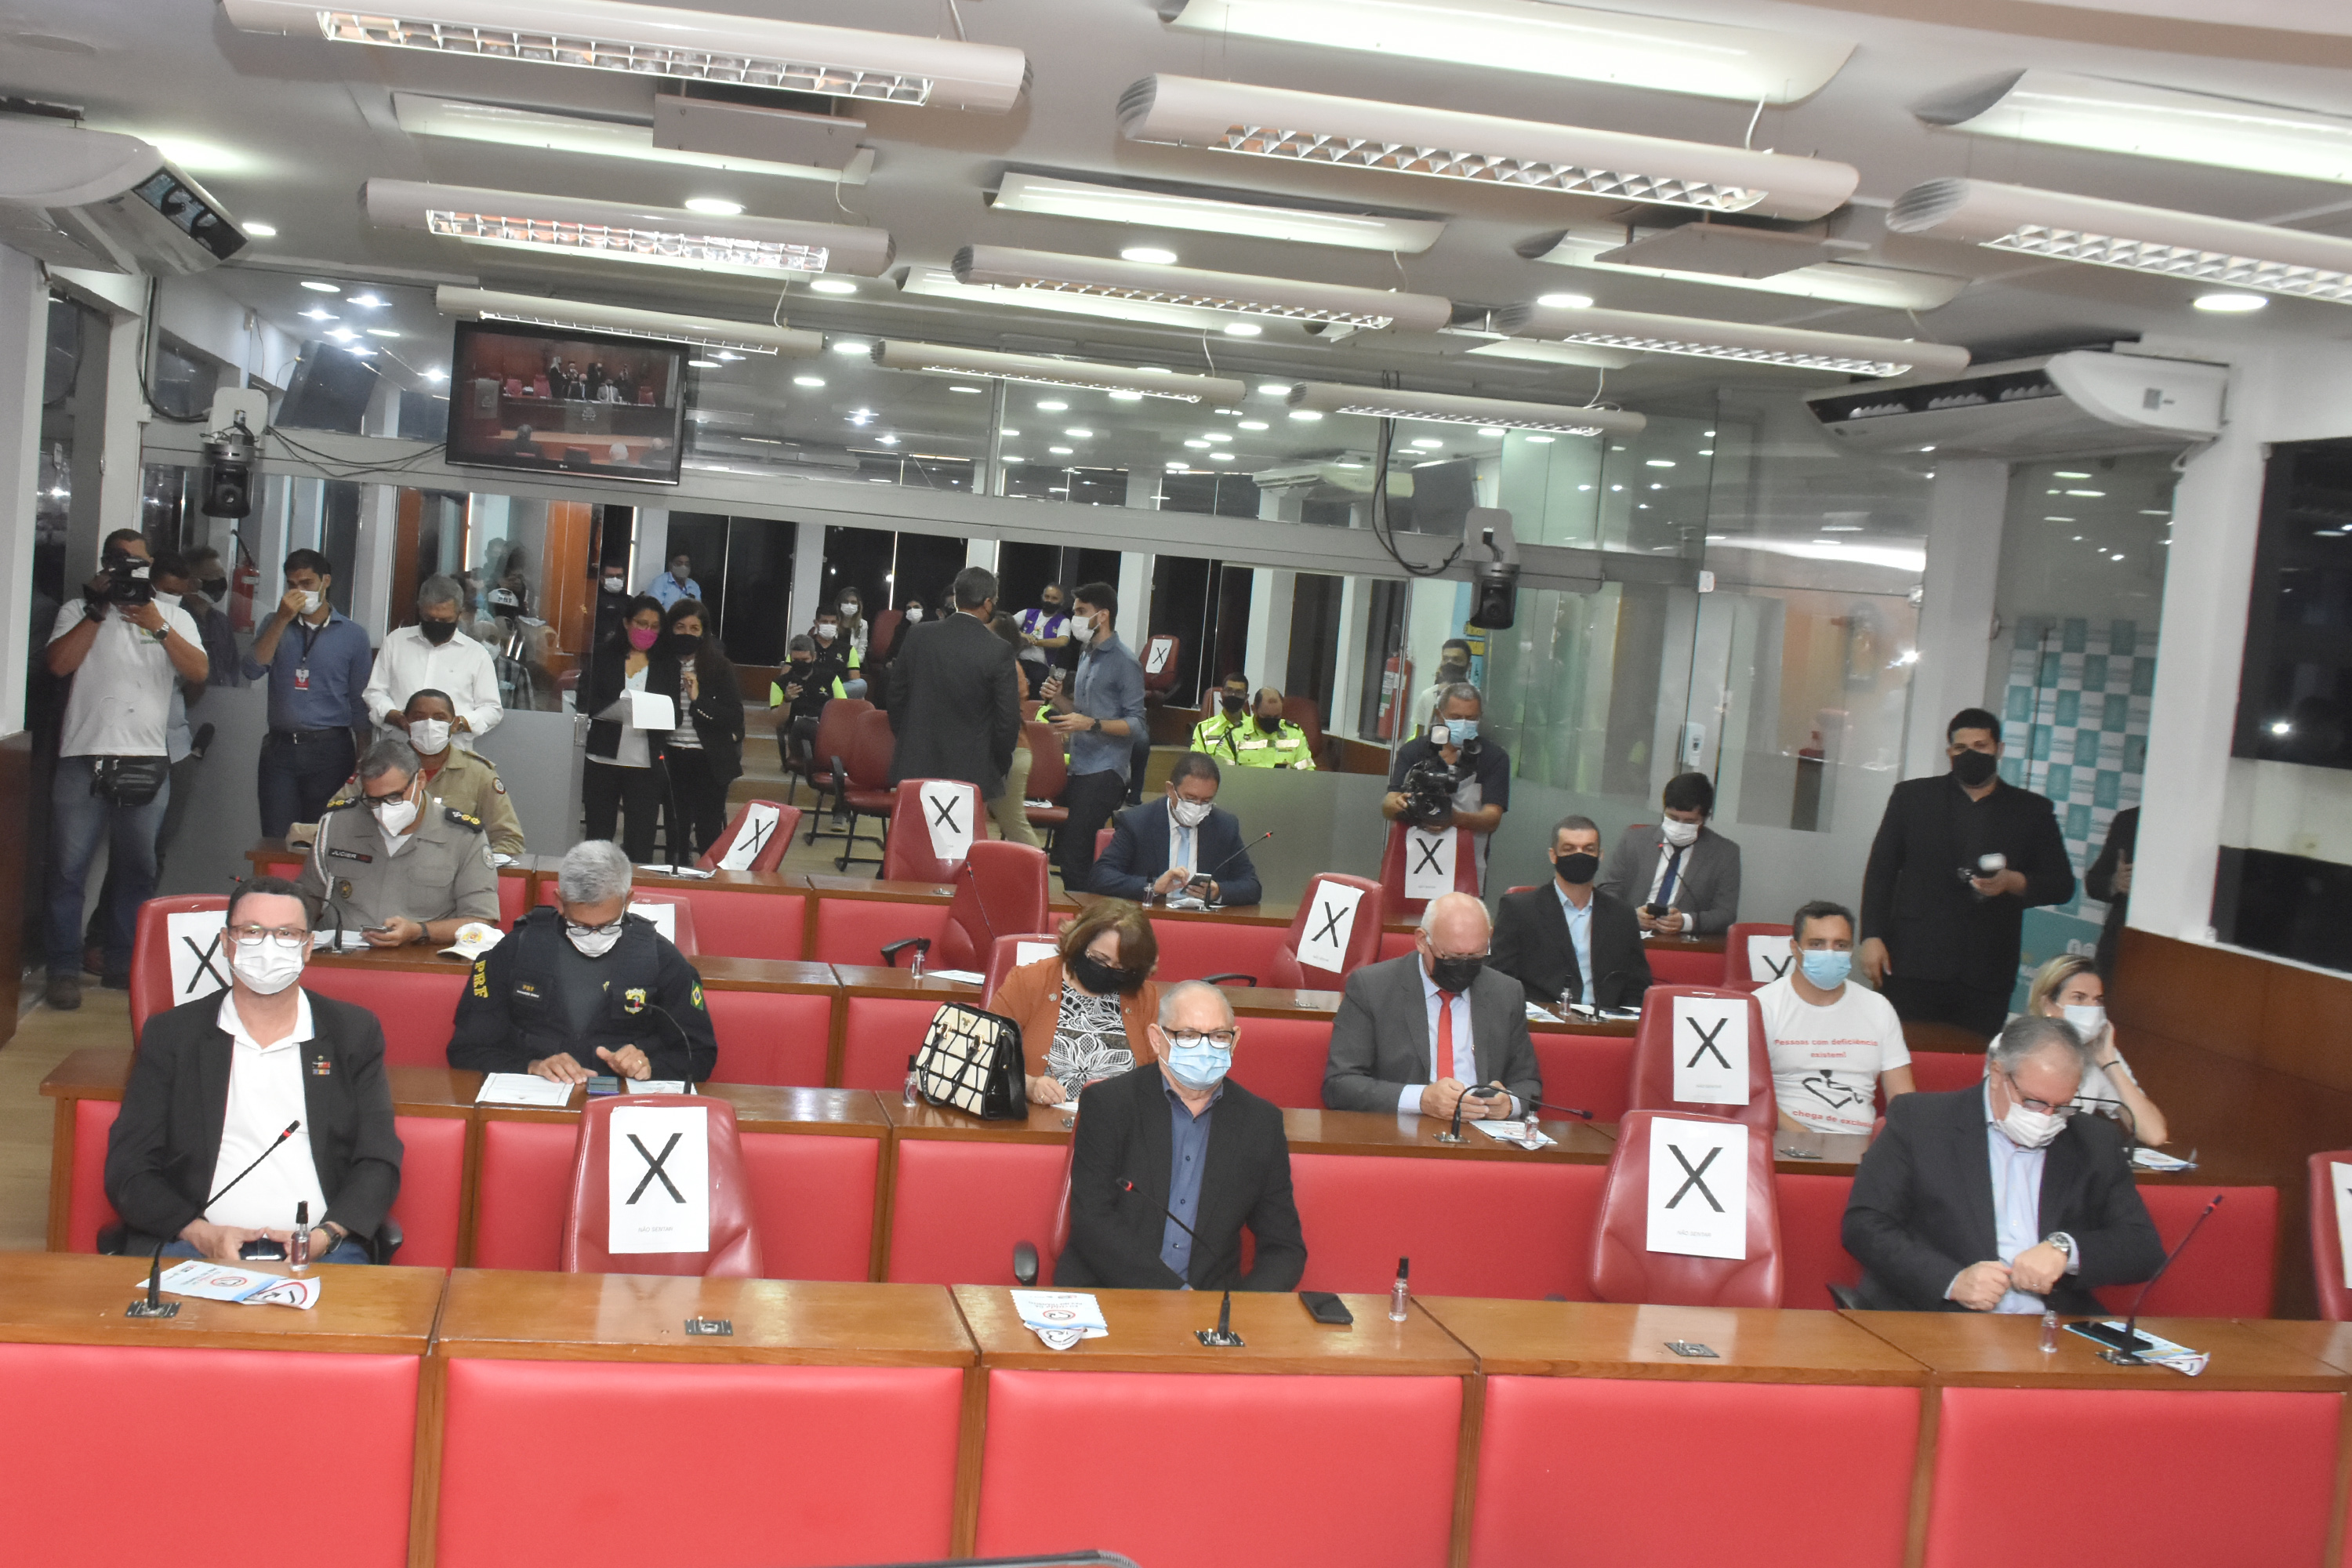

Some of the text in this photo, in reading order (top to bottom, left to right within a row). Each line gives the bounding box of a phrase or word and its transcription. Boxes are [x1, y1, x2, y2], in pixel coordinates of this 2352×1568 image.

[1152, 647, 1167, 664] X
[929, 795, 961, 834] X
[738, 818, 775, 853] X
[1413, 838, 1443, 876] X
[1311, 902, 1350, 948] X
[182, 932, 231, 994] X
[474, 960, 489, 998] PRF
[1686, 1017, 1732, 1069] X
[1831, 1038, 1878, 1047] deficiência
[1793, 1109, 1824, 1120] chega
[626, 1133, 687, 1205] X
[1664, 1144, 1726, 1213] X
